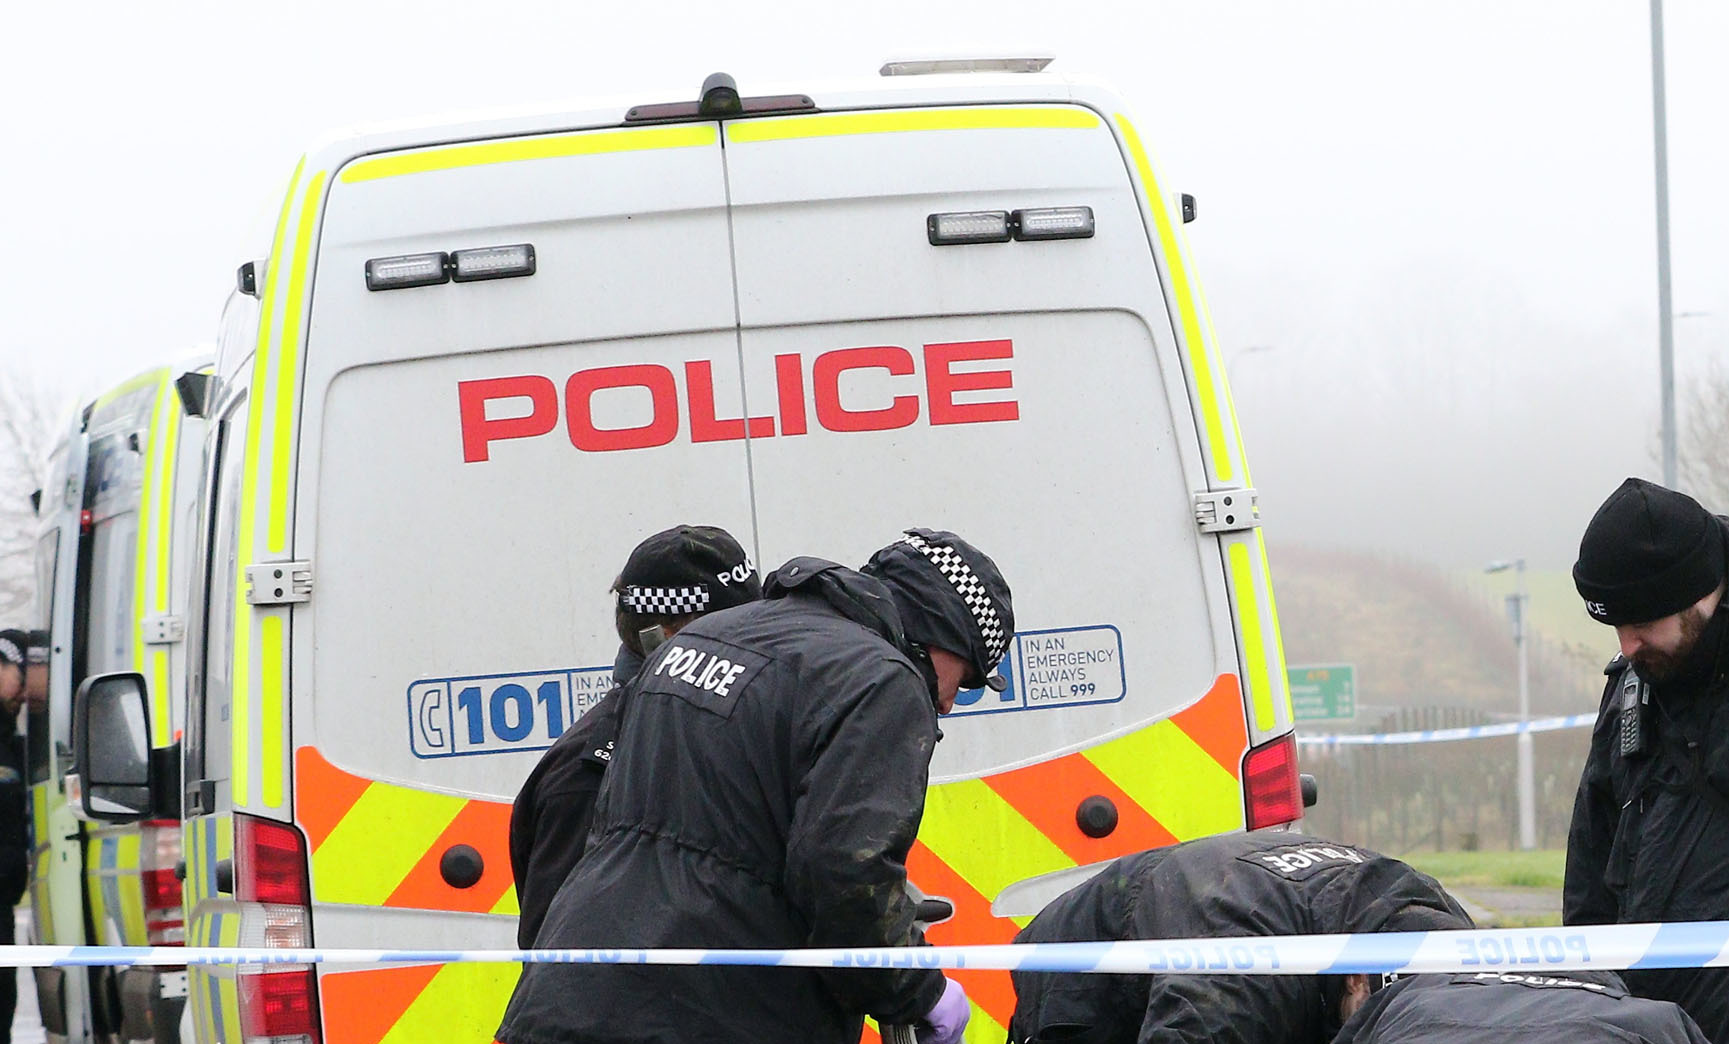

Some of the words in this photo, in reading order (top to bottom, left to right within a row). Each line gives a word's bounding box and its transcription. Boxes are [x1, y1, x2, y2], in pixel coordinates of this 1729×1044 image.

[458, 339, 1020, 463] POLICE
[1026, 639, 1040, 653] IN
[1045, 638, 1065, 650] AN
[1028, 650, 1114, 669] EMERGENCY
[655, 646, 746, 697] POLICE
[1029, 668, 1087, 685] ALWAYS
[576, 677, 591, 690] IN
[1030, 686, 1067, 701] CALL
[1070, 683, 1096, 697] 999
[458, 680, 564, 744] 101
